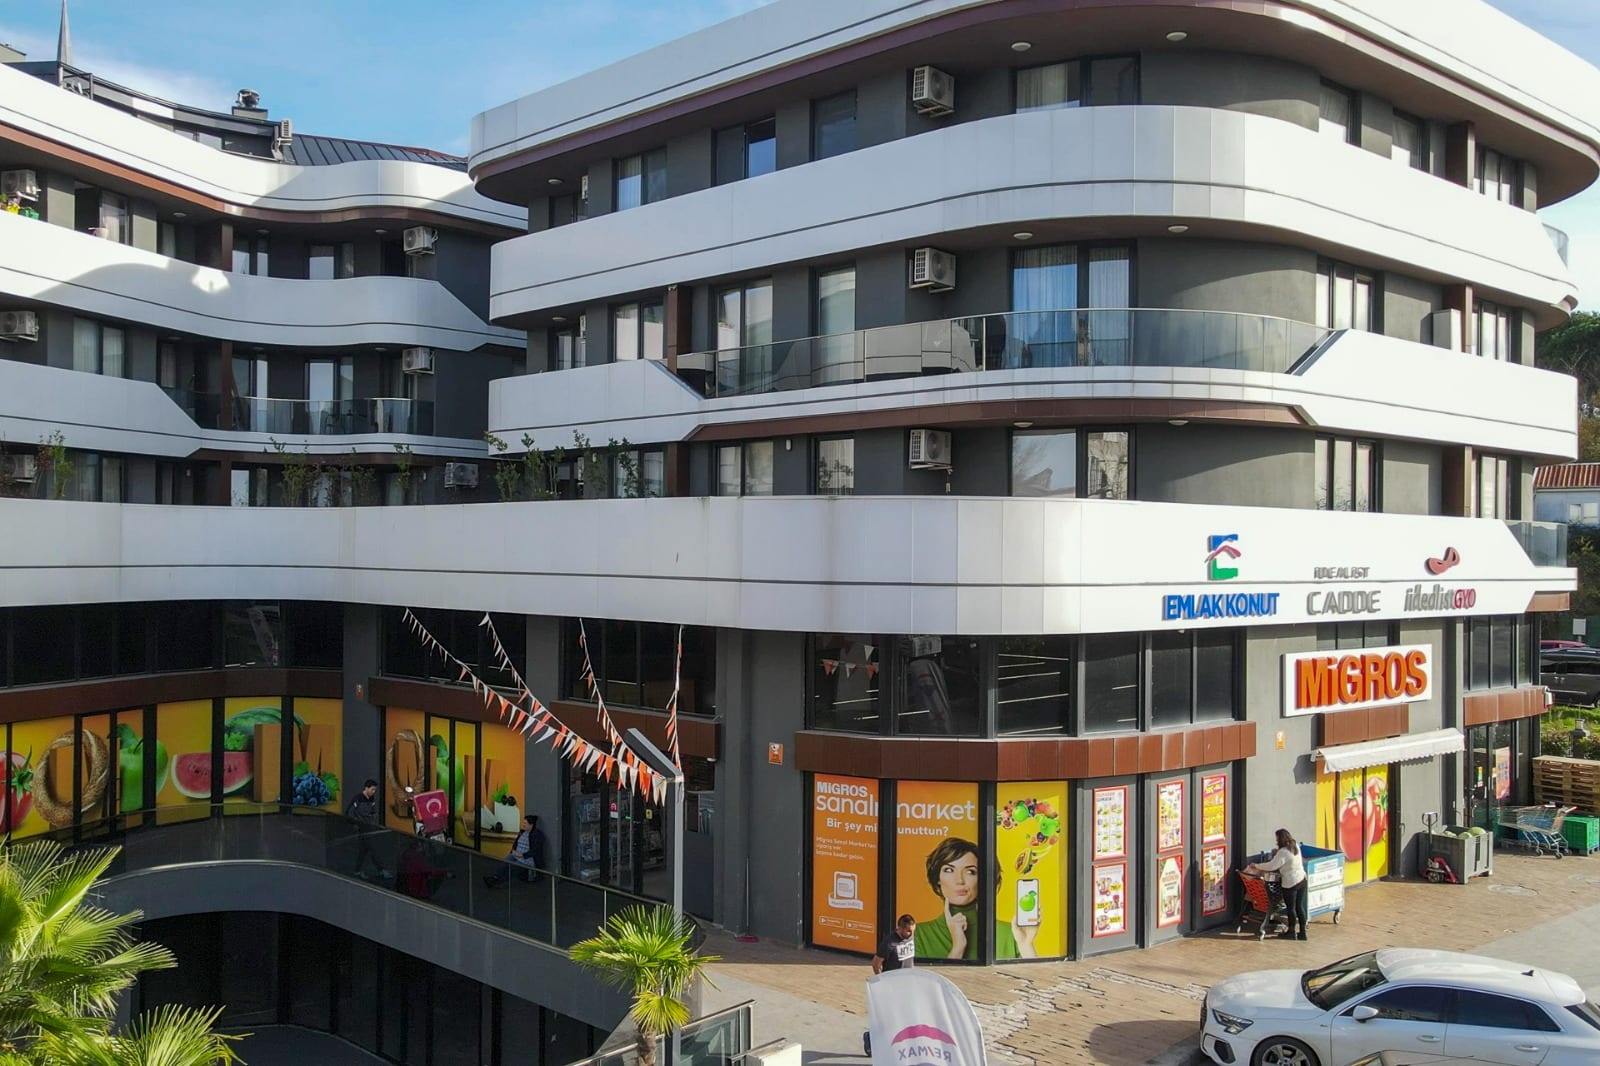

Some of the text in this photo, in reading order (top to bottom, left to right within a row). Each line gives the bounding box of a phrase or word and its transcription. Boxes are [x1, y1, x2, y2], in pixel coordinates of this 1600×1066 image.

[1163, 592, 1280, 621] EMLAK KONUT
[1306, 590, 1381, 616] CADDE
[826, 817, 842, 829] Bir
[844, 821, 862, 834] şey
[897, 826, 949, 837] unuttun?
